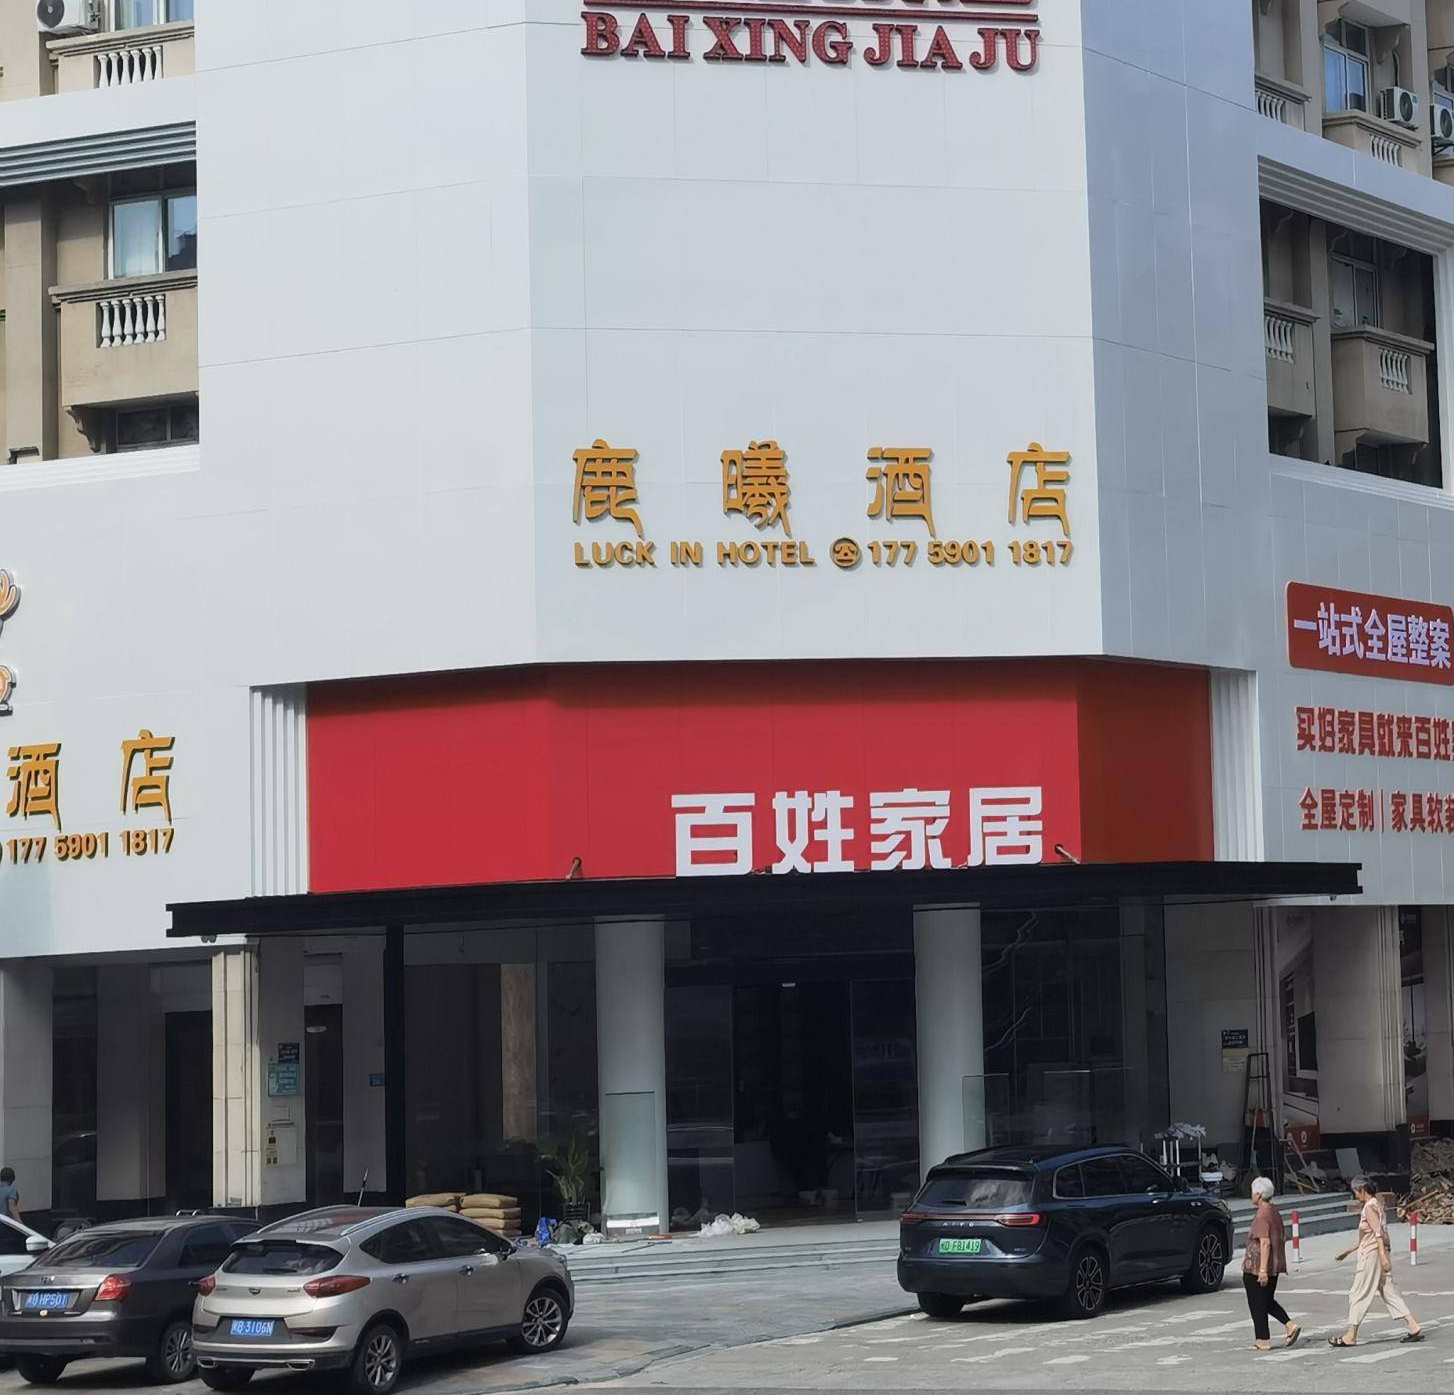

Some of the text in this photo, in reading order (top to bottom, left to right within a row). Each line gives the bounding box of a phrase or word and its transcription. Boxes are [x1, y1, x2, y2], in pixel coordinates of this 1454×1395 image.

[580, 11, 690, 58] BAI
[702, 16, 853, 64] XING
[574, 540, 1074, 568] LUCK IN HOTEL 177 5901 1817
[1293, 601, 1452, 668] 一站式全屋整案
[5, 827, 175, 864] 177 5901 1817
[671, 786, 1044, 877] 百姓家居
